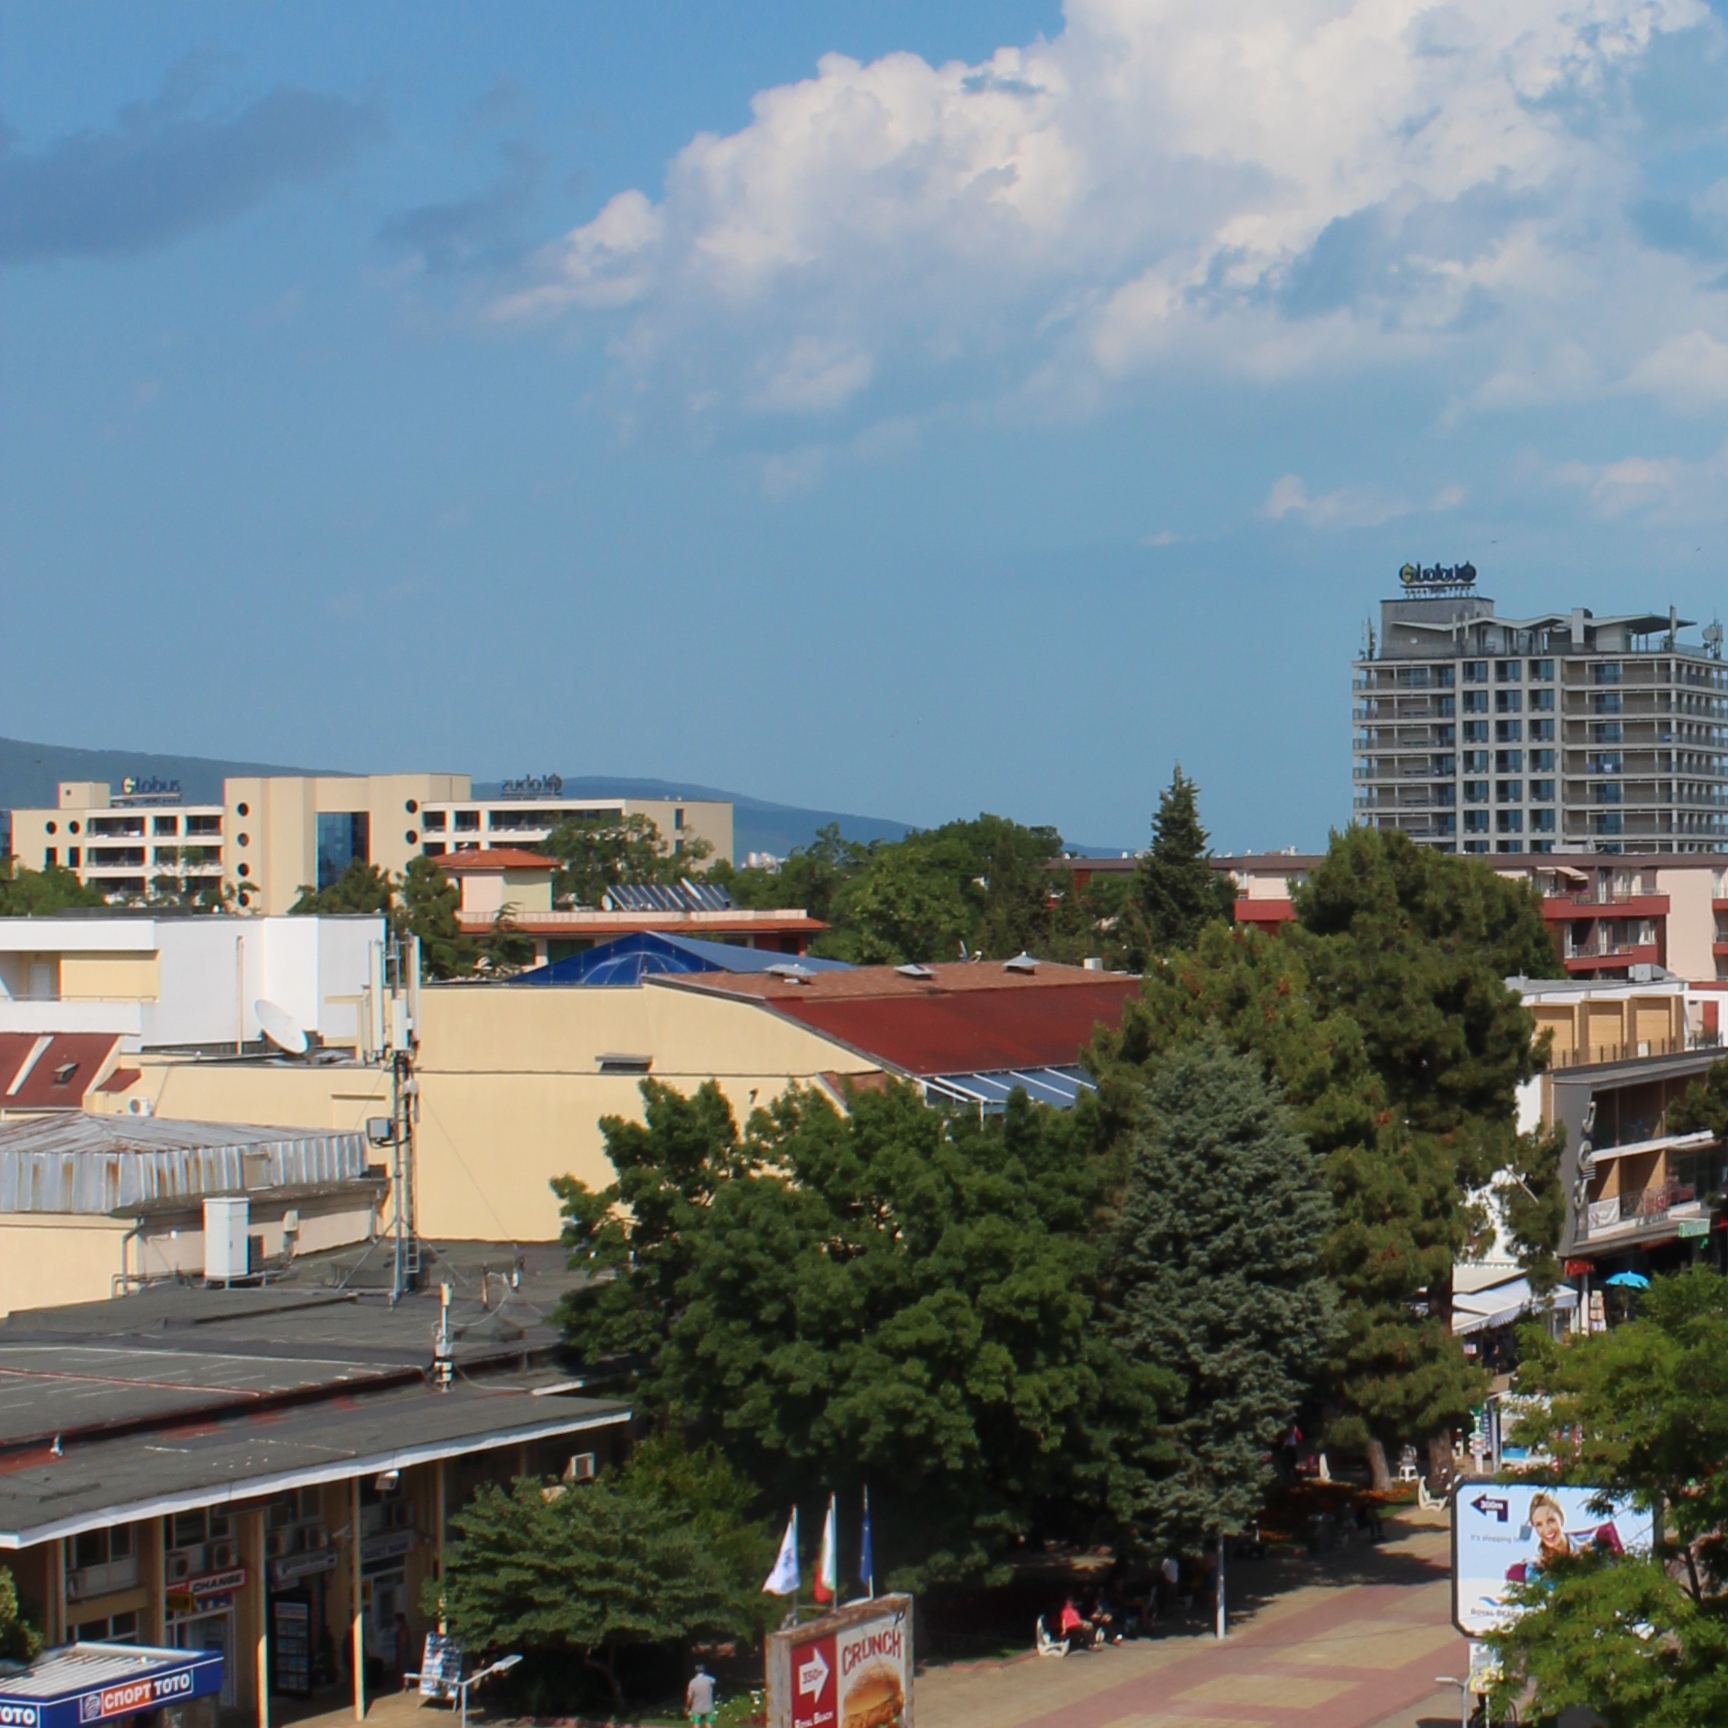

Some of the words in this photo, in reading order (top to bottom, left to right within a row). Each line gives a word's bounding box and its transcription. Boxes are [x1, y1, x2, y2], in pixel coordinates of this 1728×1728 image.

[192, 1573, 242, 1593] CHANGE
[841, 1628, 901, 1676] CRUNCH
[104, 1683, 151, 1710] СПОРТ
[153, 1673, 190, 1696] ТОТО
[0, 1708, 36, 1725] ОТО
